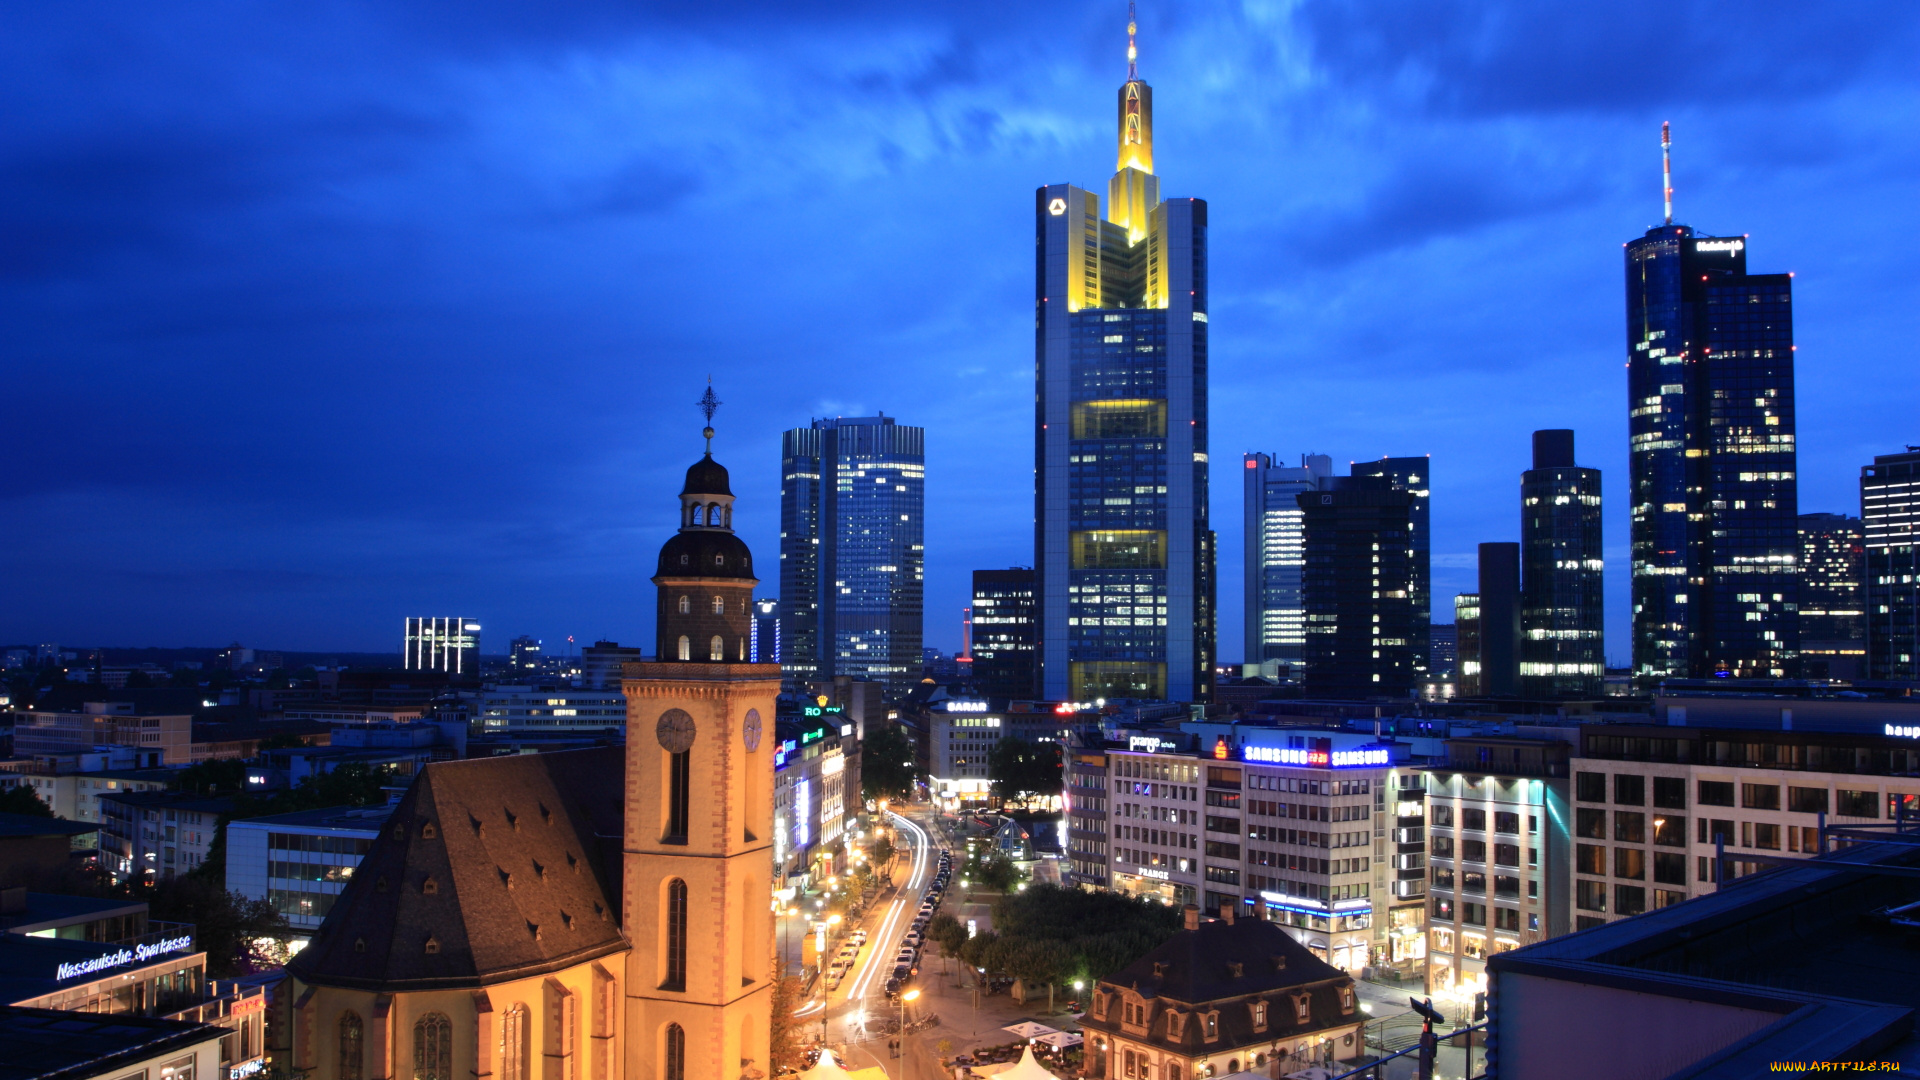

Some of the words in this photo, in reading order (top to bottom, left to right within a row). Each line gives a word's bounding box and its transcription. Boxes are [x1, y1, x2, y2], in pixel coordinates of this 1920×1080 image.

[947, 702, 987, 712] SARAR
[1130, 736, 1160, 753] prange
[1245, 746, 1307, 764] SAMSUNG
[1331, 749, 1388, 766] SAMSUNG
[1138, 867, 1169, 880] PRANGE
[56, 949, 132, 981] Nassauische
[135, 935, 192, 962] Sparkasse
